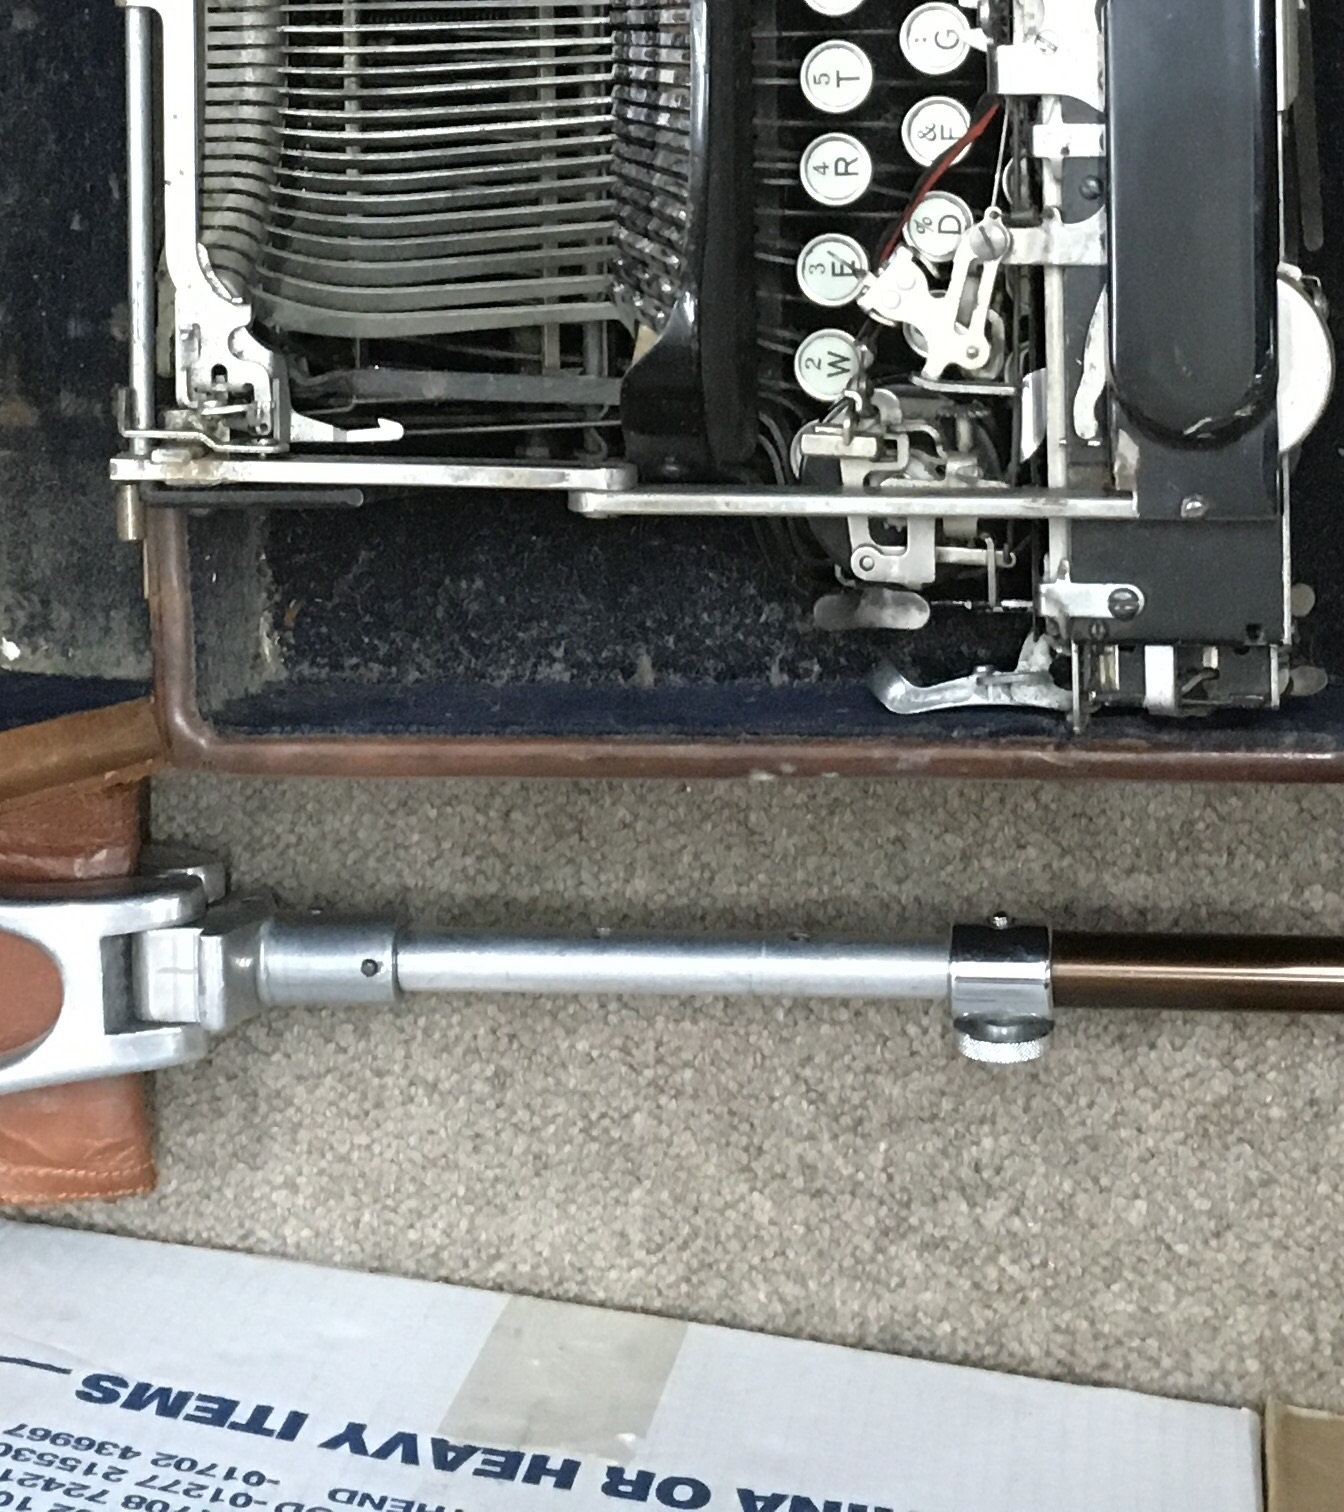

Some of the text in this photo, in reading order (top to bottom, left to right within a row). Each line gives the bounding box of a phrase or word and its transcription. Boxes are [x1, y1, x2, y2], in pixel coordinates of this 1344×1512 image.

[935, 29, 959, 50] G
[813, 72, 830, 86] 5
[836, 70, 860, 88] T
[813, 162, 829, 176] 4
[835, 157, 859, 176] R
[938, 215, 962, 235] D
[809, 263, 825, 275] 3
[805, 357, 821, 370] 2
[827, 351, 850, 377] W
[2, 1422, 142, 1460] 436967
[74, 1373, 712, 1509] OR HEAVY ITEMS
